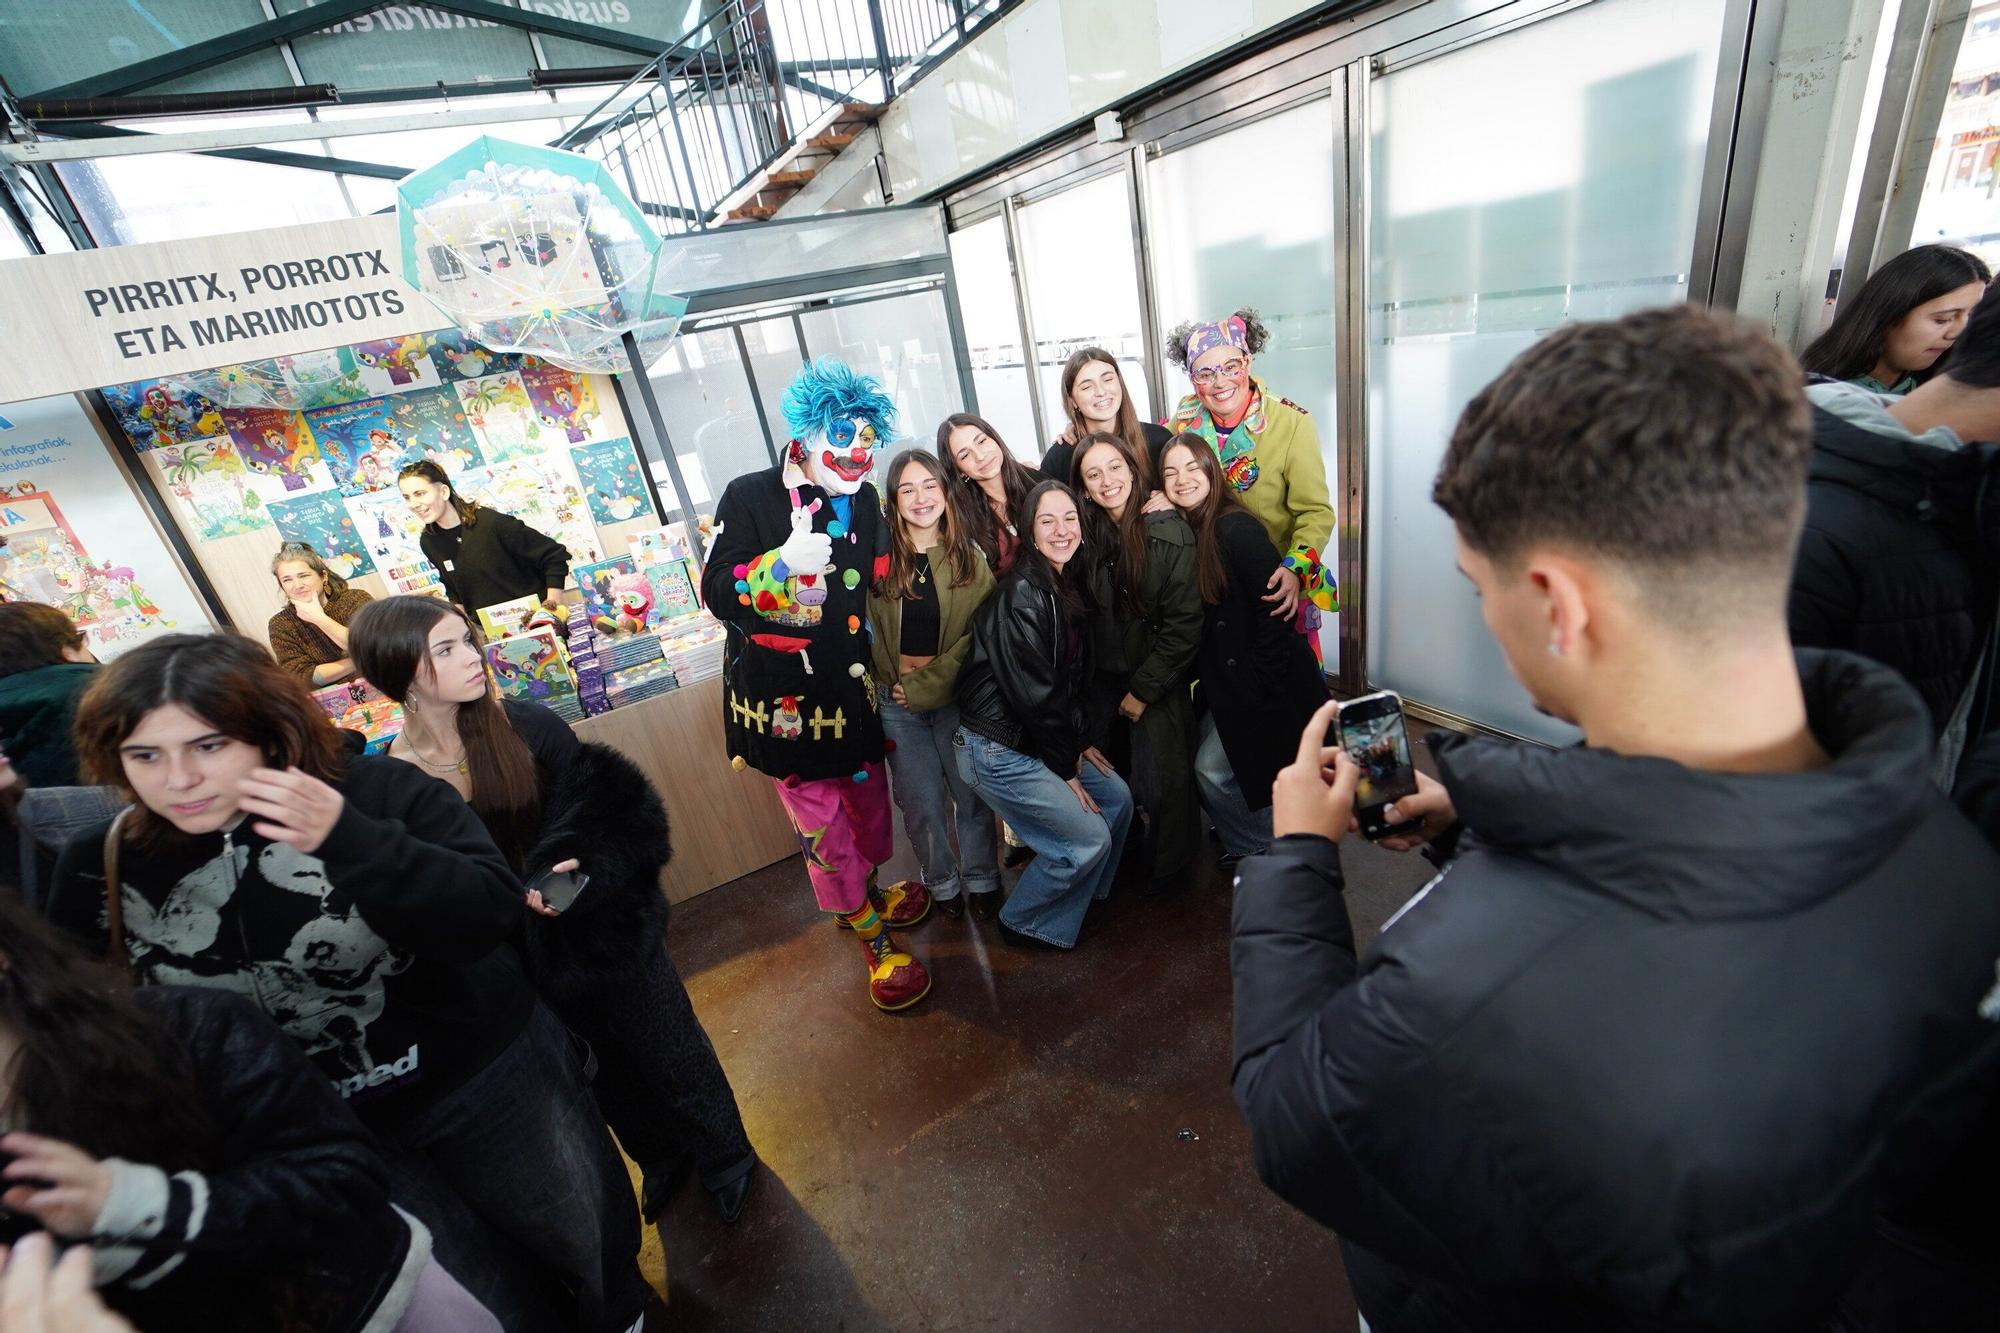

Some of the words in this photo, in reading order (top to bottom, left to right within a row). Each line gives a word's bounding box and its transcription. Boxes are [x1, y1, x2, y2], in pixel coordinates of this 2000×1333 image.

[84, 272, 237, 317] PIRRITX,
[240, 249, 391, 295] PORROTX
[114, 323, 187, 359] ETA
[189, 289, 405, 347] MARIMOTOTS
[331, 1043, 419, 1099] ped
